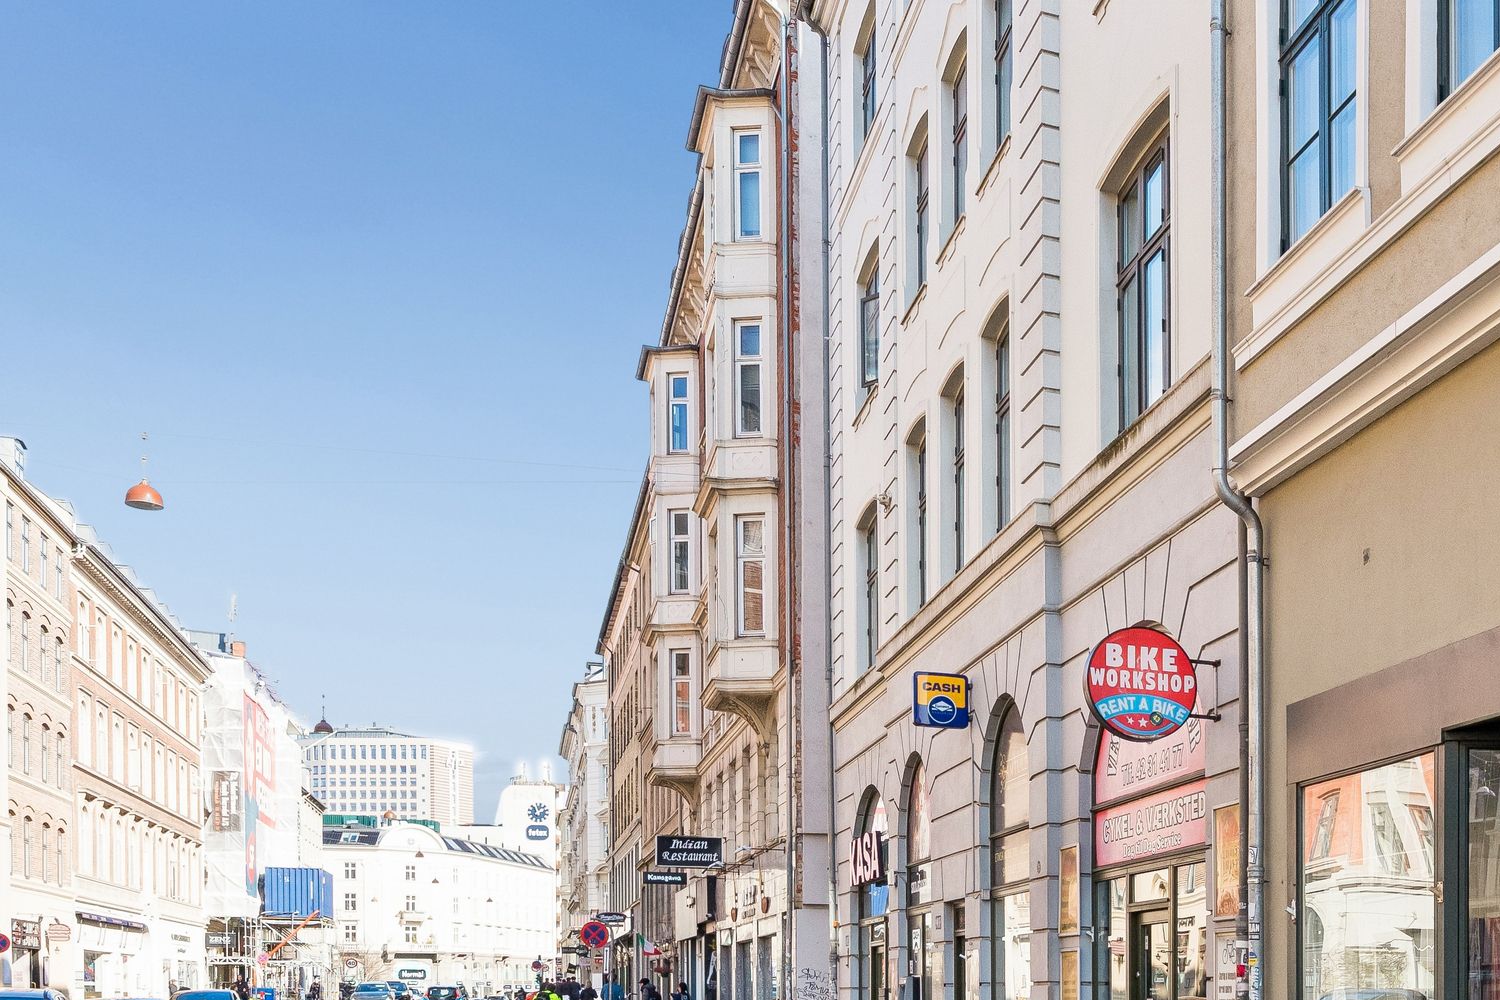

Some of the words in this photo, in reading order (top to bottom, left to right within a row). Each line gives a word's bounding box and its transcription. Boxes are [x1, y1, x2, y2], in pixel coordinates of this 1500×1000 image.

[1105, 643, 1178, 672] BIKE
[922, 681, 961, 693] CASH
[1090, 666, 1195, 693] WORKSHOP
[1098, 697, 1136, 719] RENT
[1138, 697, 1149, 711] A
[1152, 698, 1187, 722] BIKE
[1135, 757, 1146, 781] 42
[1147, 752, 1158, 777] 31
[1159, 748, 1170, 773] 41
[1172, 743, 1184, 768] 77
[1102, 813, 1134, 844] CYKEL
[1135, 810, 1144, 835] &
[1145, 790, 1206, 833] VÆRKSTED
[662, 851, 719, 862] Restaurant
[670, 839, 708, 850] Indian
[1122, 842, 1135, 859] Dag
[1135, 840, 1143, 855] til
[1143, 837, 1157, 855] Dag
[1157, 832, 1182, 850] Service
[849, 831, 880, 887] KASA
[208, 935, 231, 945] ZENZ
[401, 970, 424, 978] Normal
